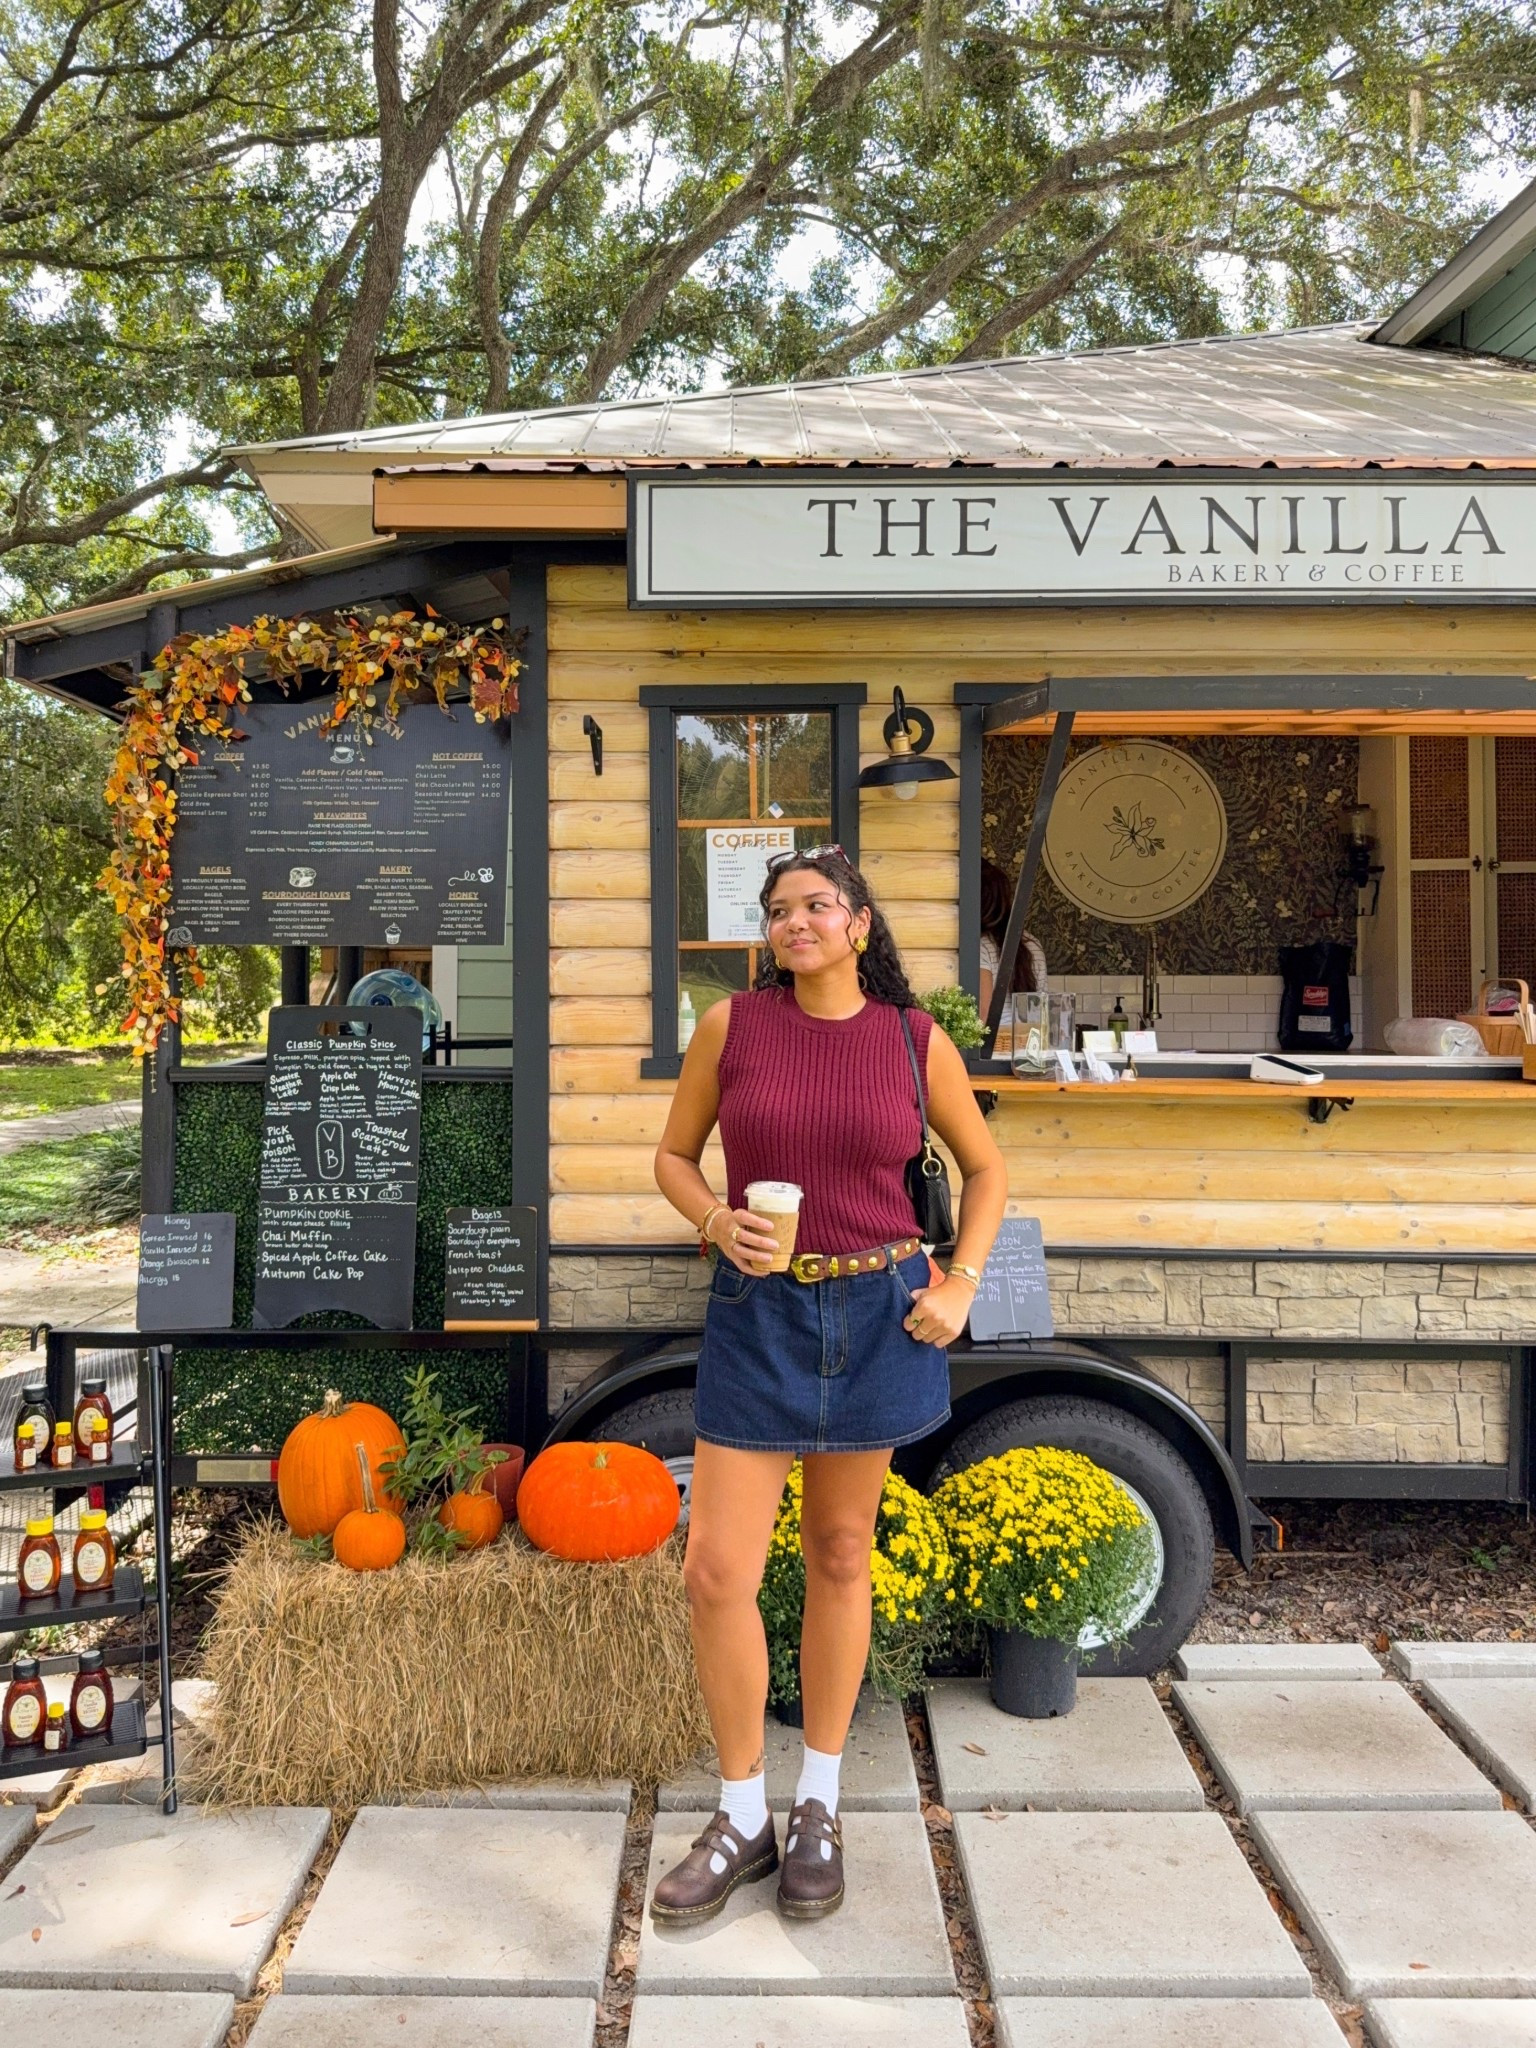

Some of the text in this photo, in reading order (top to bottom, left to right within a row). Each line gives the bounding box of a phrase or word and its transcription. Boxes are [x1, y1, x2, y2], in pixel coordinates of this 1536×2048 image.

[808, 496, 1505, 558] THE VANILLA
[1169, 564, 1463, 583] BAKERY & COFFEE
[326, 734, 360, 743] MENU
[213, 752, 245, 762] COFFEE
[432, 752, 484, 762] NOT COFFEE
[301, 768, 384, 777] Add Flavor Cold Foam
[1068, 752, 1202, 796] VANILLA BEAN
[203, 791, 231, 800] Espresso
[443, 790, 476, 799] Beverages
[313, 811, 368, 821] VB FAVORITES
[712, 832, 791, 849] COFFEE
[199, 865, 232, 875] BAGELS
[379, 865, 412, 875] BAKERY
[1065, 850, 1117, 901] BAKERY
[1152, 847, 1201, 900] COFFEE
[262, 890, 318, 900] SOURDOUGH
[448, 891, 479, 901] HONEY
[286, 1038, 397, 1051] Classic Pumpkin Spice
[393, 1053, 411, 1062] with
[317, 1062, 332, 1070] cold
[365, 1062, 379, 1072] hug
[319, 1071, 358, 1082] Apple Oat
[378, 1070, 418, 1089] Harvest
[276, 1088, 300, 1100] Latte
[321, 1083, 361, 1094] Crisp Latte
[377, 1080, 421, 1100] Moon Latte
[364, 1121, 408, 1141] Toasted
[352, 1128, 411, 1153] Scarecrow
[360, 1140, 390, 1157] Latte
[288, 1186, 371, 1202] BAKERY
[471, 1207, 503, 1223] Bagels
[164, 1215, 191, 1231] Honey
[1005, 1220, 1033, 1236] YOUR
[141, 1230, 213, 1243] Coffee Infused 16
[262, 1230, 332, 1242] Chai Muffin
[447, 1222, 511, 1239] Sourdough plain
[140, 1242, 213, 1255] Vanilla Infused 22
[447, 1235, 521, 1249] Sourdough everything
[261, 1249, 389, 1266] Spiced Apple Coffee Cake
[448, 1249, 502, 1259] French toast
[139, 1257, 211, 1272] Orange Blossom 12
[261, 1265, 365, 1281] Autumn Cake Pop
[138, 1273, 169, 1287] Allergy
